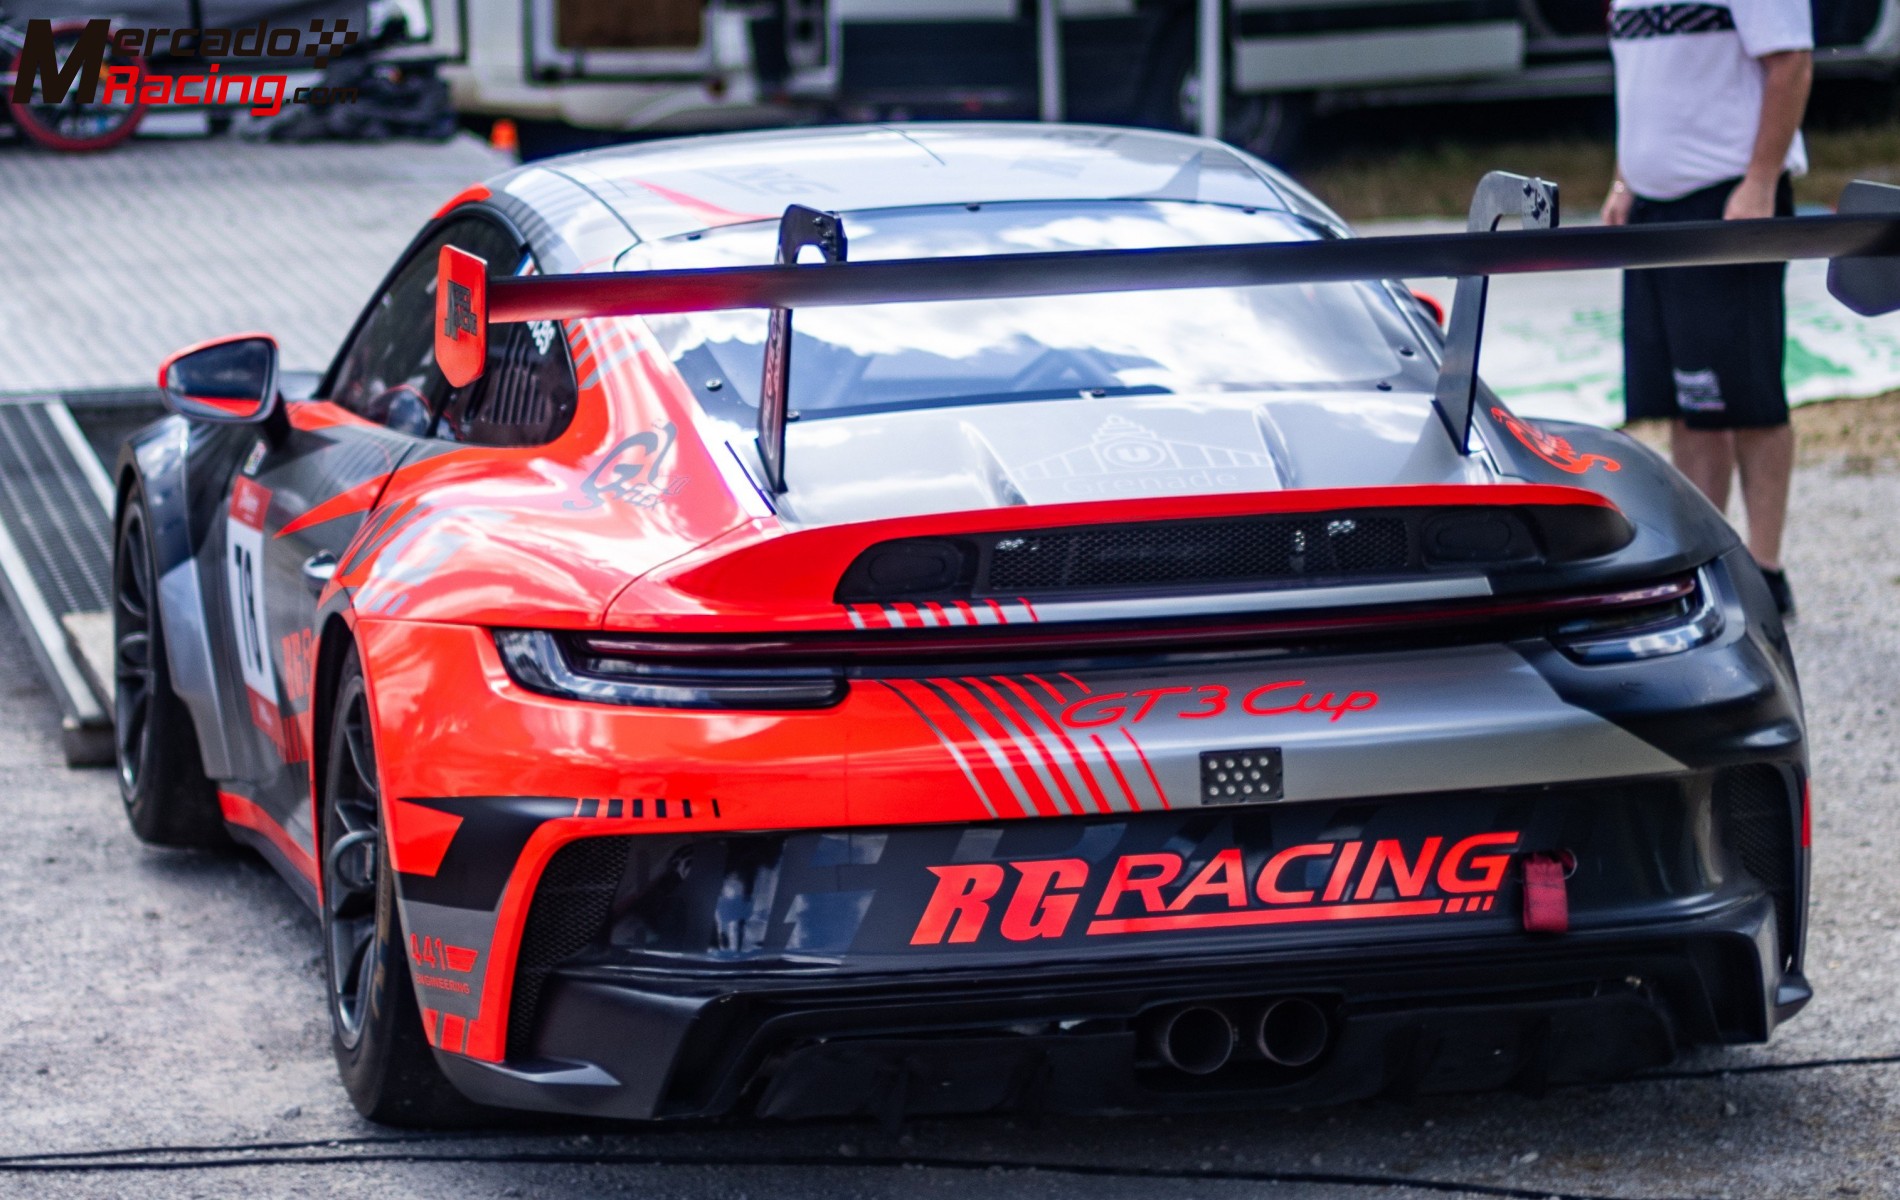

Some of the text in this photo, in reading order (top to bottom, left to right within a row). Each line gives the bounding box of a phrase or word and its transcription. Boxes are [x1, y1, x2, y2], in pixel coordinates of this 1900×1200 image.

[1062, 470, 1238, 495] Grenade
[1241, 680, 1379, 723] Cup
[909, 831, 1519, 945] RG RACING
[411, 932, 446, 970] 441
[415, 973, 470, 994] ENGINEERING
